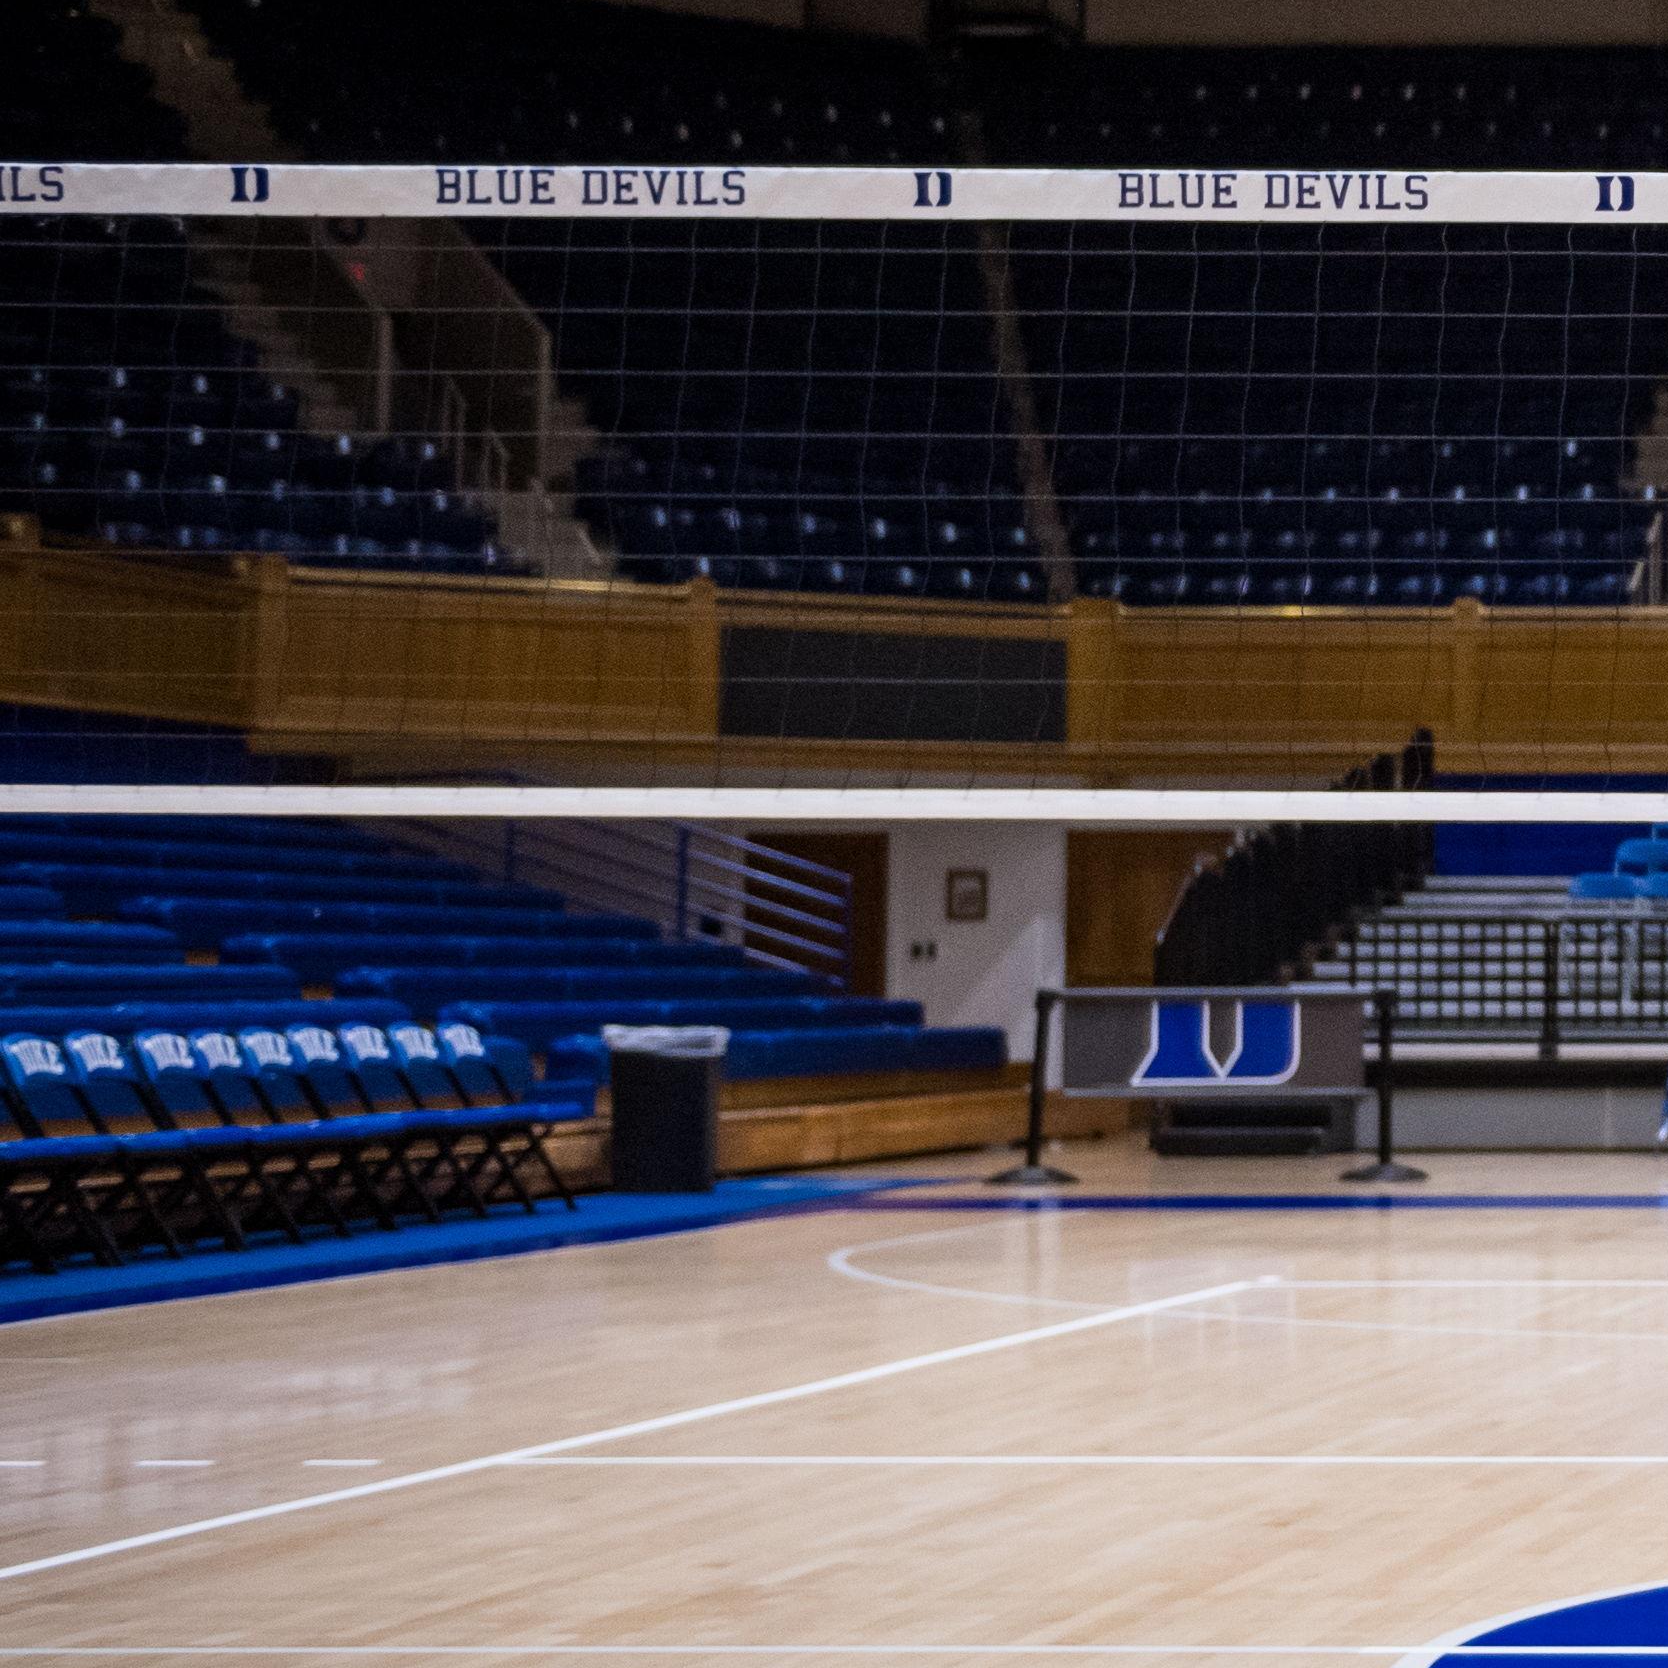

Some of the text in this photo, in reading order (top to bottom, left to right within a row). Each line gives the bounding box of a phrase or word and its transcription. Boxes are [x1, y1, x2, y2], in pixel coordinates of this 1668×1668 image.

[436, 169, 746, 206] BLUE DEVILS
[1118, 173, 1429, 210] BLUE DEVILS
